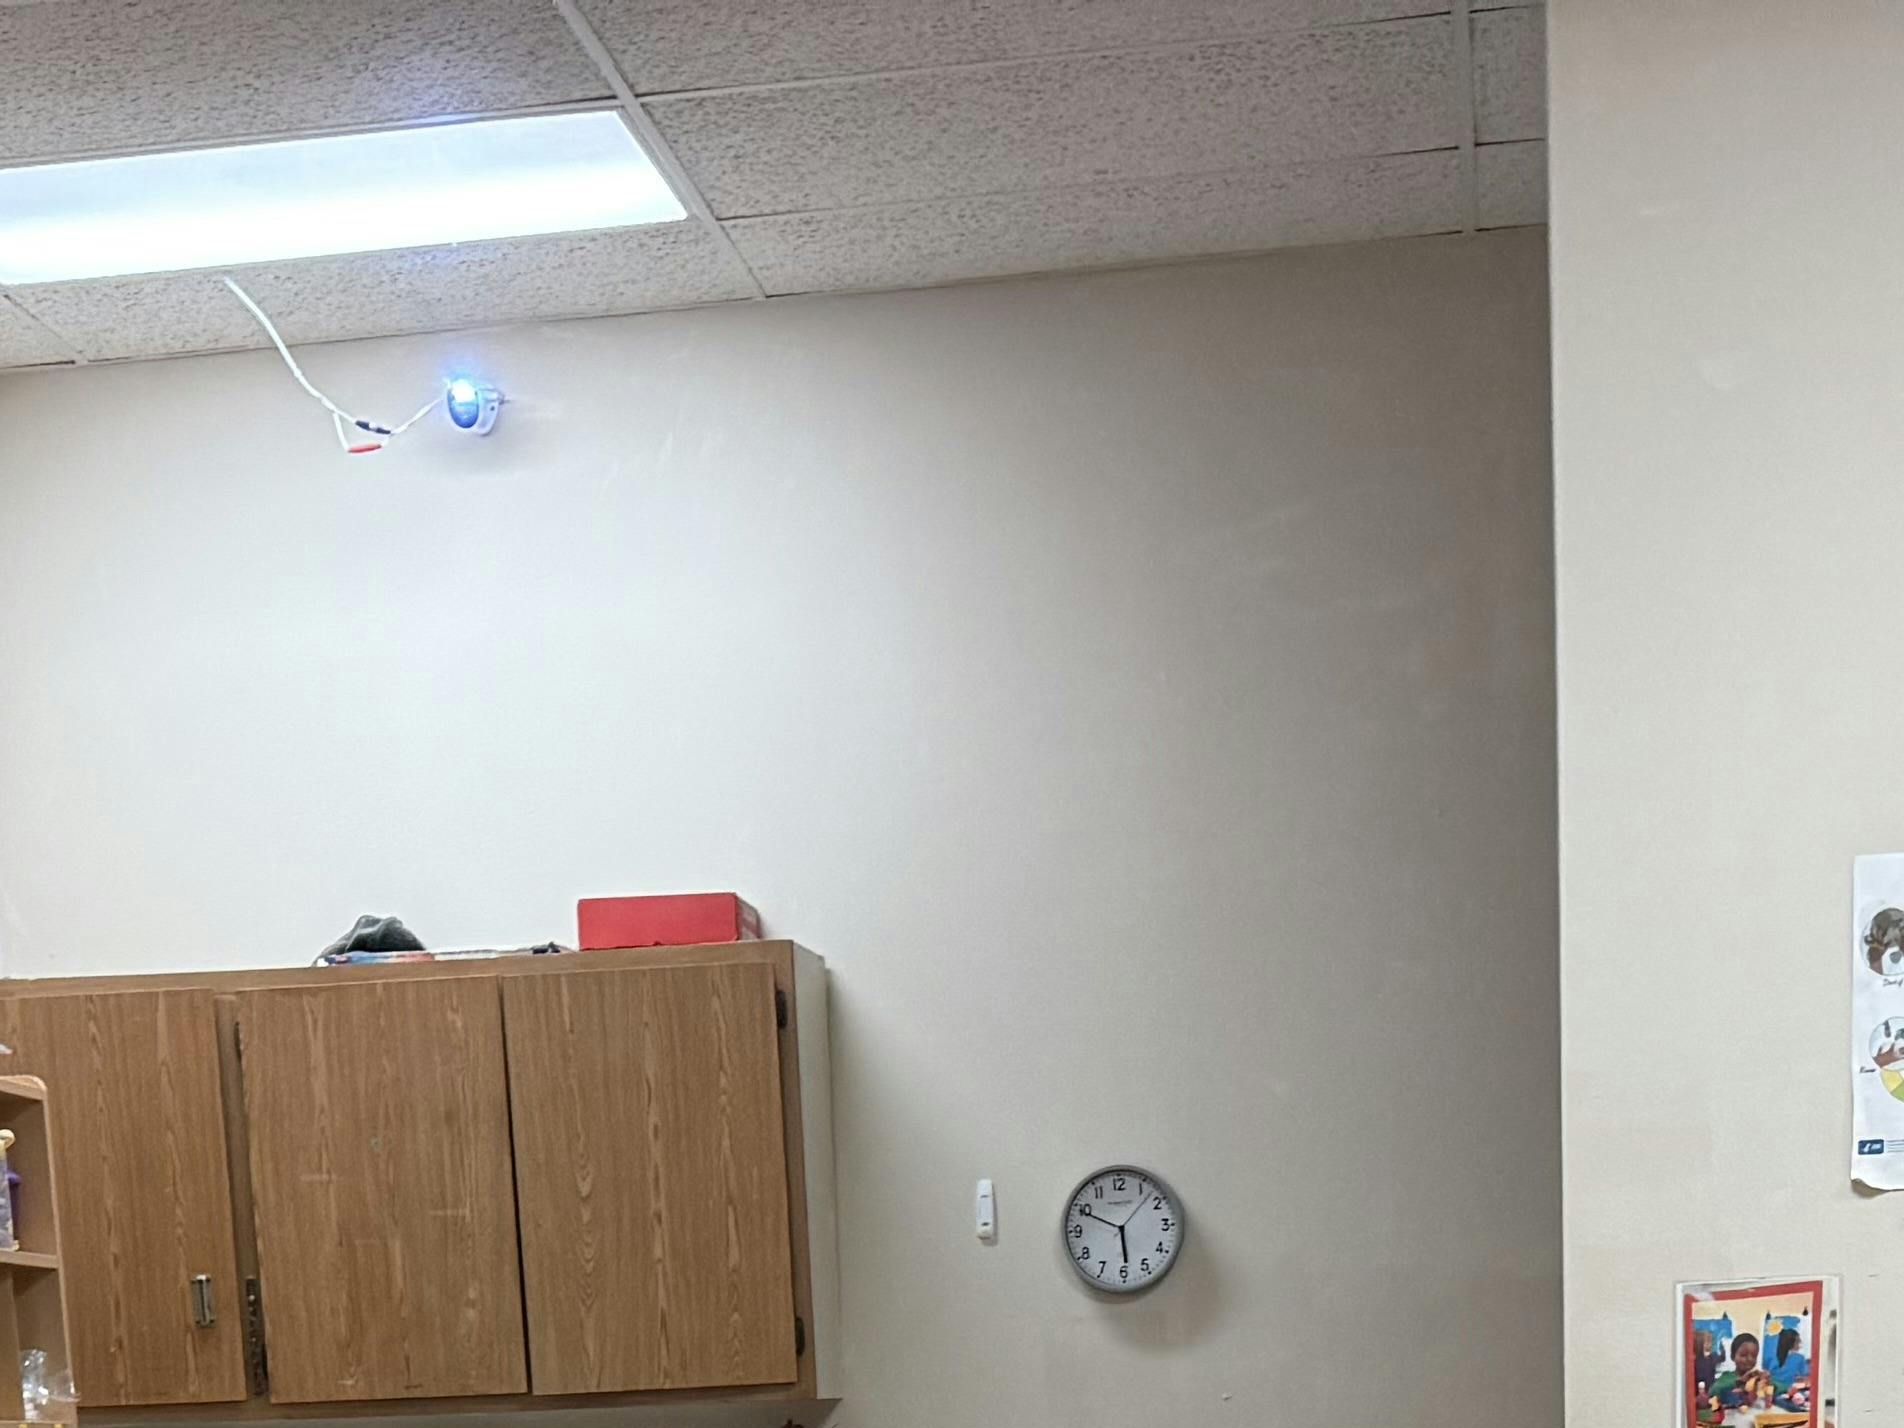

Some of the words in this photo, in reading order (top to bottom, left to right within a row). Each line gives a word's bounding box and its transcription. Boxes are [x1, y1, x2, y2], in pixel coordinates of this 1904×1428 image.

[1112, 1177, 1126, 1191] 12
[1094, 1185, 1103, 1199] 11
[1079, 1203, 1092, 1216] 10
[1153, 1196, 1162, 1210] 2
[1161, 1218, 1170, 1231] 3
[1074, 1225, 1083, 1238] 9
[1081, 1247, 1090, 1260] 8
[1155, 1241, 1164, 1253] 4
[1097, 1261, 1107, 1274] 7
[1140, 1258, 1149, 1271] 5
[1119, 1265, 1128, 1279] 6
